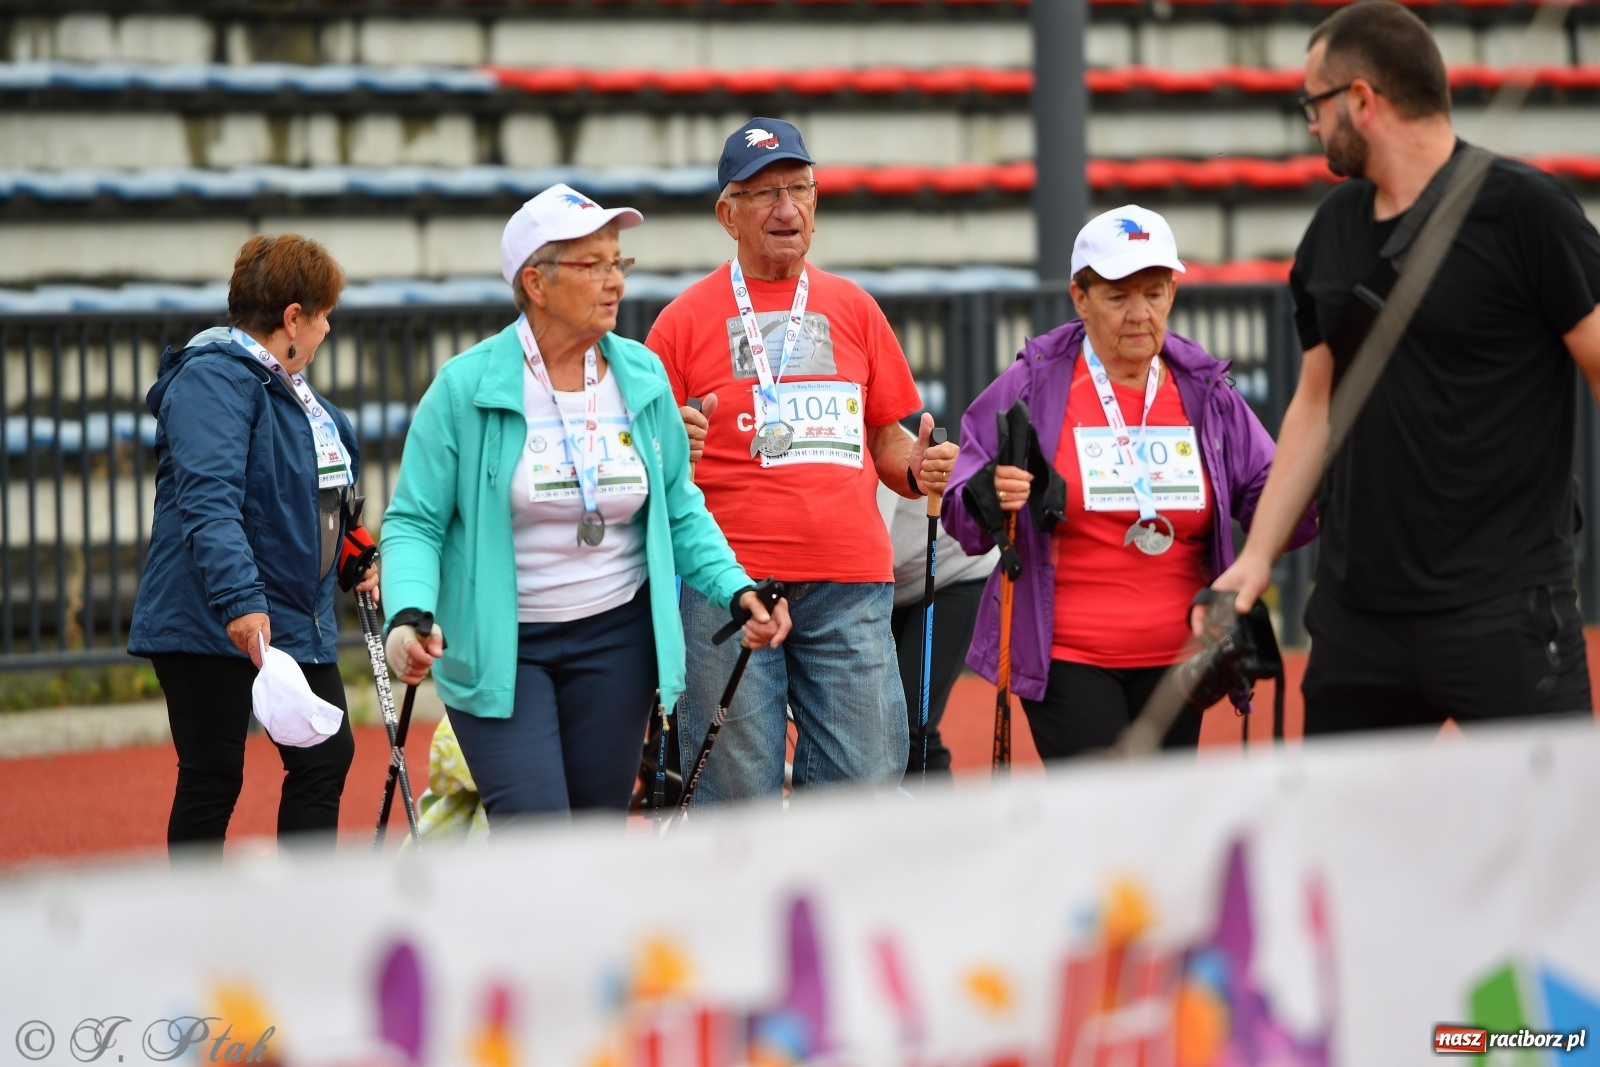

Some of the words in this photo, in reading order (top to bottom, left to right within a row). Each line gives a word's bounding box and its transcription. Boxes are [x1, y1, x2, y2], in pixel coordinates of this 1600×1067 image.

[787, 396, 841, 422] 104
[556, 435, 614, 466] 11
[1111, 440, 1168, 465] 10
